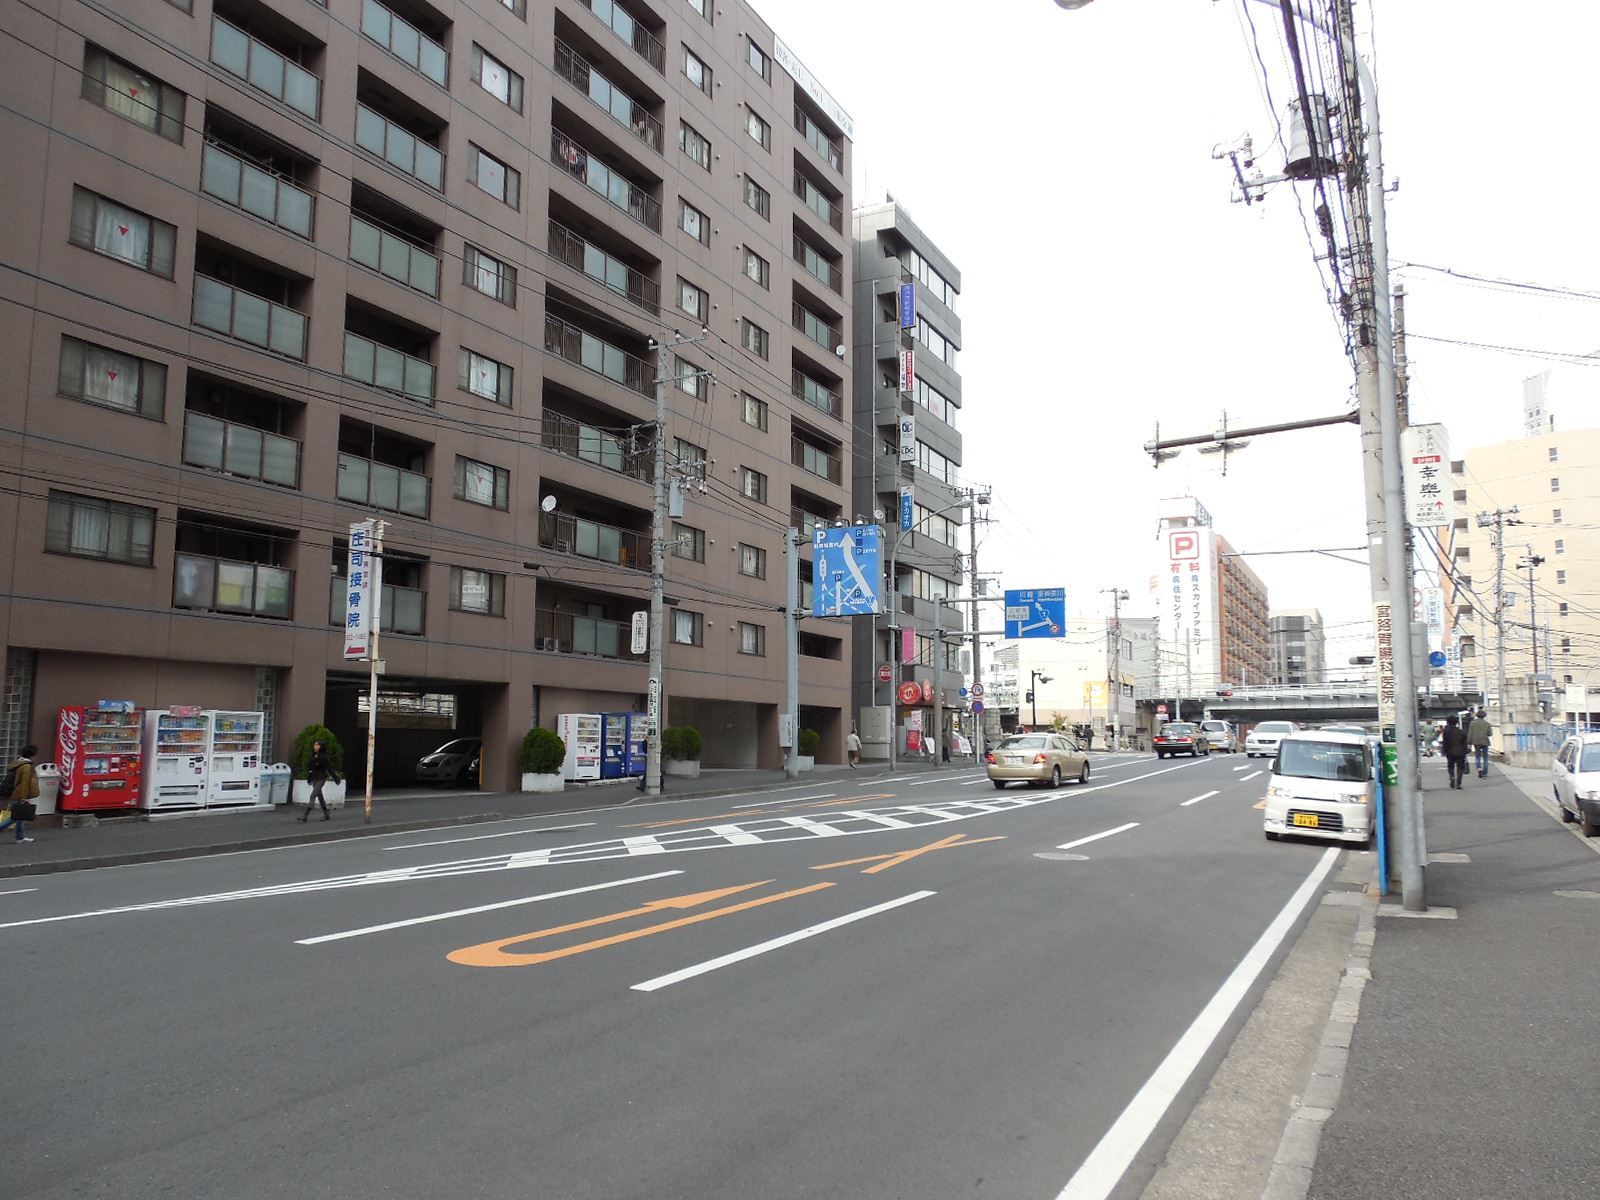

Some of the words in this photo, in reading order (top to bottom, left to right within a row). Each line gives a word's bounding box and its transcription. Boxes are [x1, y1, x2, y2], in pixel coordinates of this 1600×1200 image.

[816, 531, 826, 543] P
[1175, 536, 1194, 555] P
[348, 530, 364, 628] 庄司接骨院
